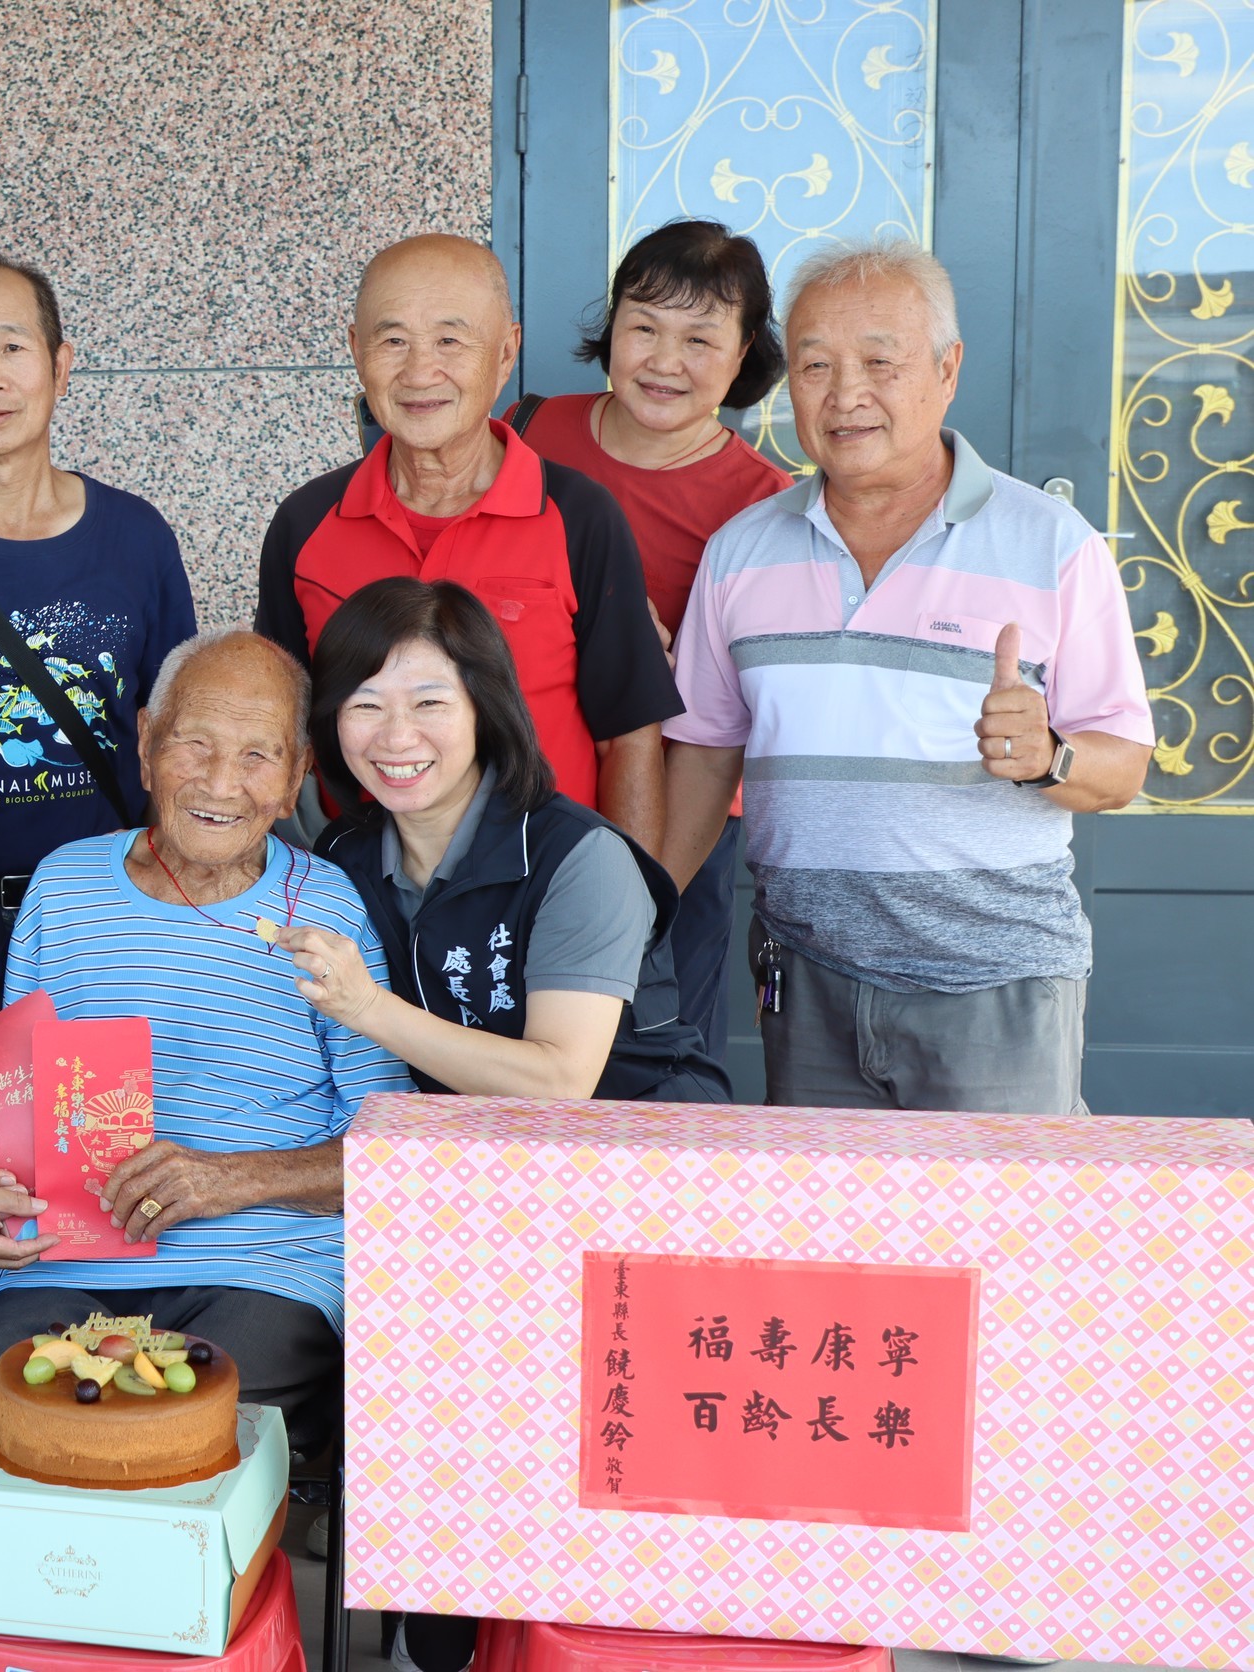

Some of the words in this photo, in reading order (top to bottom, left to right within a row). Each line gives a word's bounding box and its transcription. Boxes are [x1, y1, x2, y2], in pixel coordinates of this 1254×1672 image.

[5, 794, 46, 804] BIOLOGY
[51, 770, 97, 788] MUSE
[486, 922, 516, 1014] 社會處
[688, 1315, 920, 1378] 福壽康寧
[682, 1389, 916, 1450] 百齡長樂
